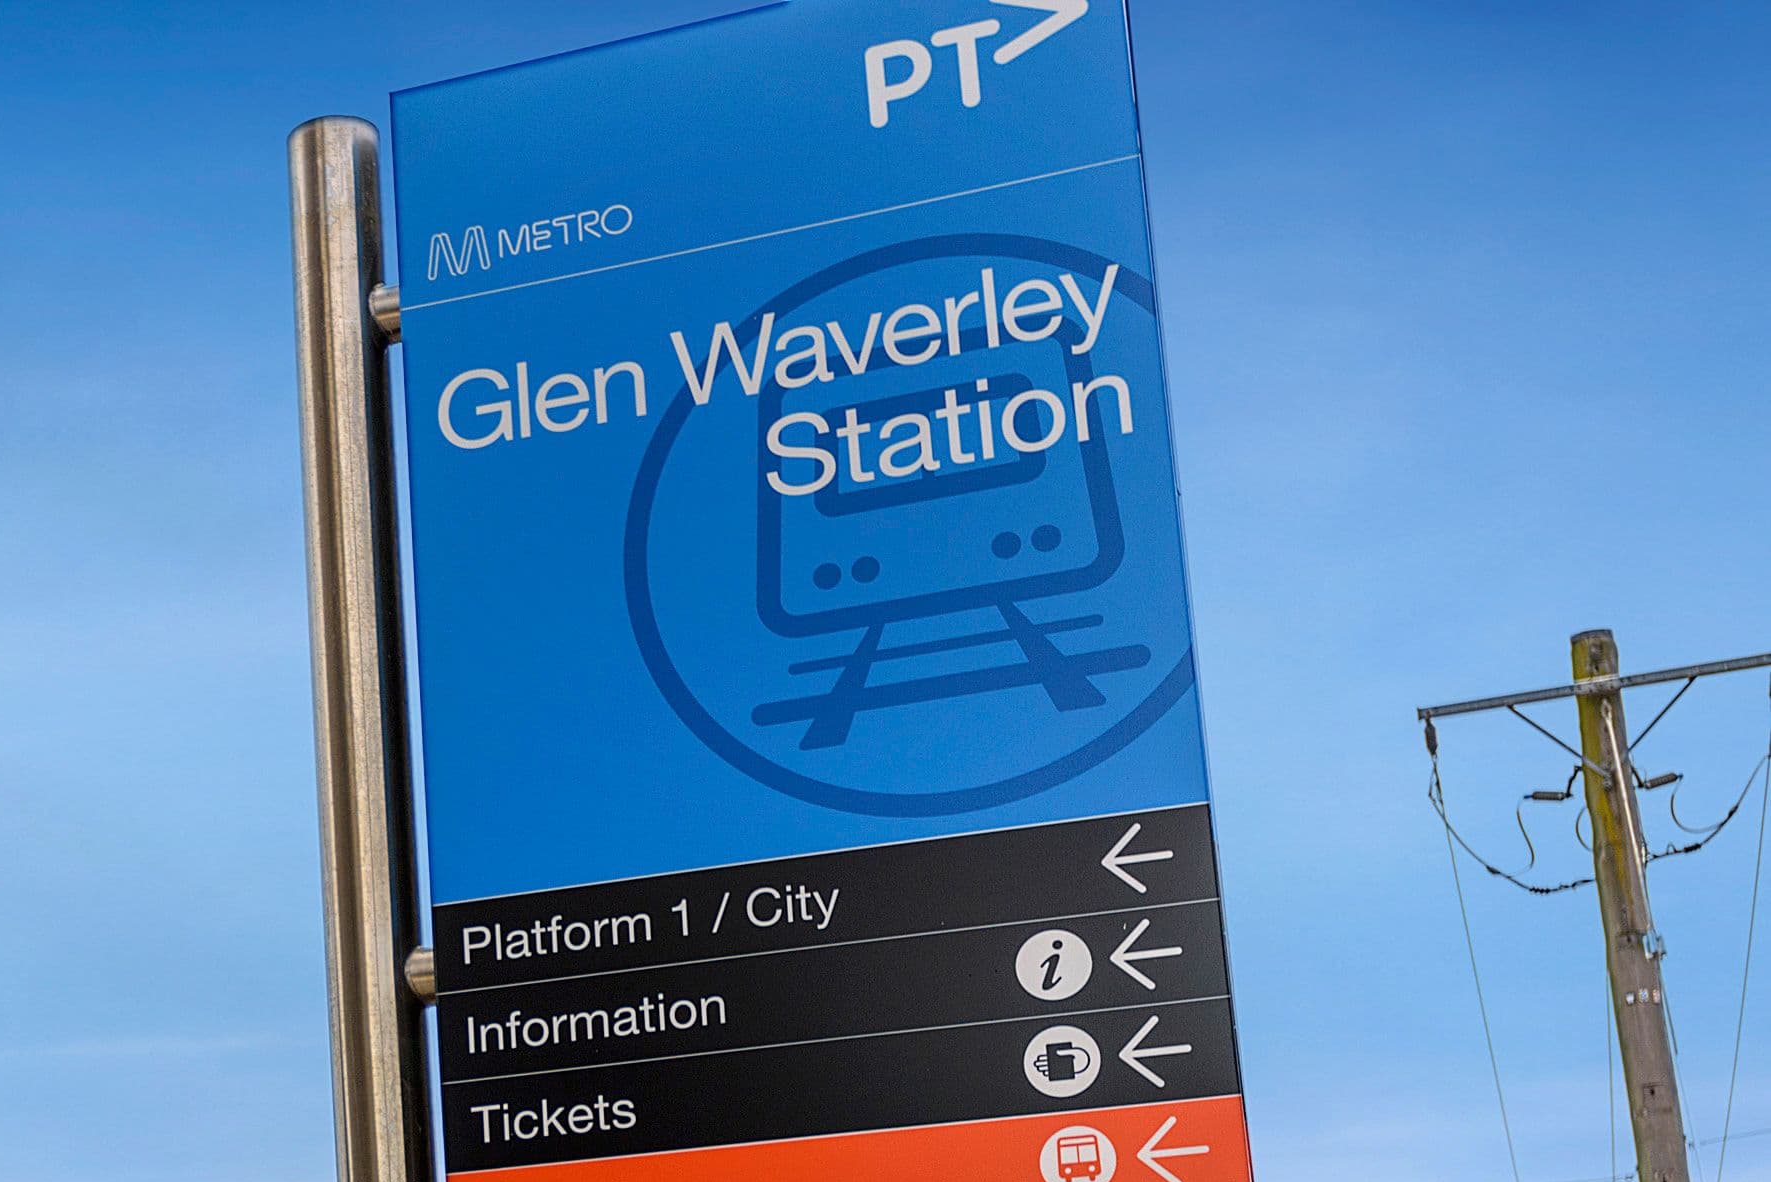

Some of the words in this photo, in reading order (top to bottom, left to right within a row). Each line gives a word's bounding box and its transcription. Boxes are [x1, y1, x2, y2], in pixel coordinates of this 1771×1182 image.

[498, 204, 633, 258] METRO
[437, 362, 647, 450] Glen
[669, 263, 1120, 406] Waverley
[766, 374, 1134, 497] Station
[461, 912, 653, 966] Platform
[670, 898, 690, 937] 1
[745, 884, 840, 931] City
[465, 994, 727, 1055] Information
[470, 1092, 638, 1143] Tickets
